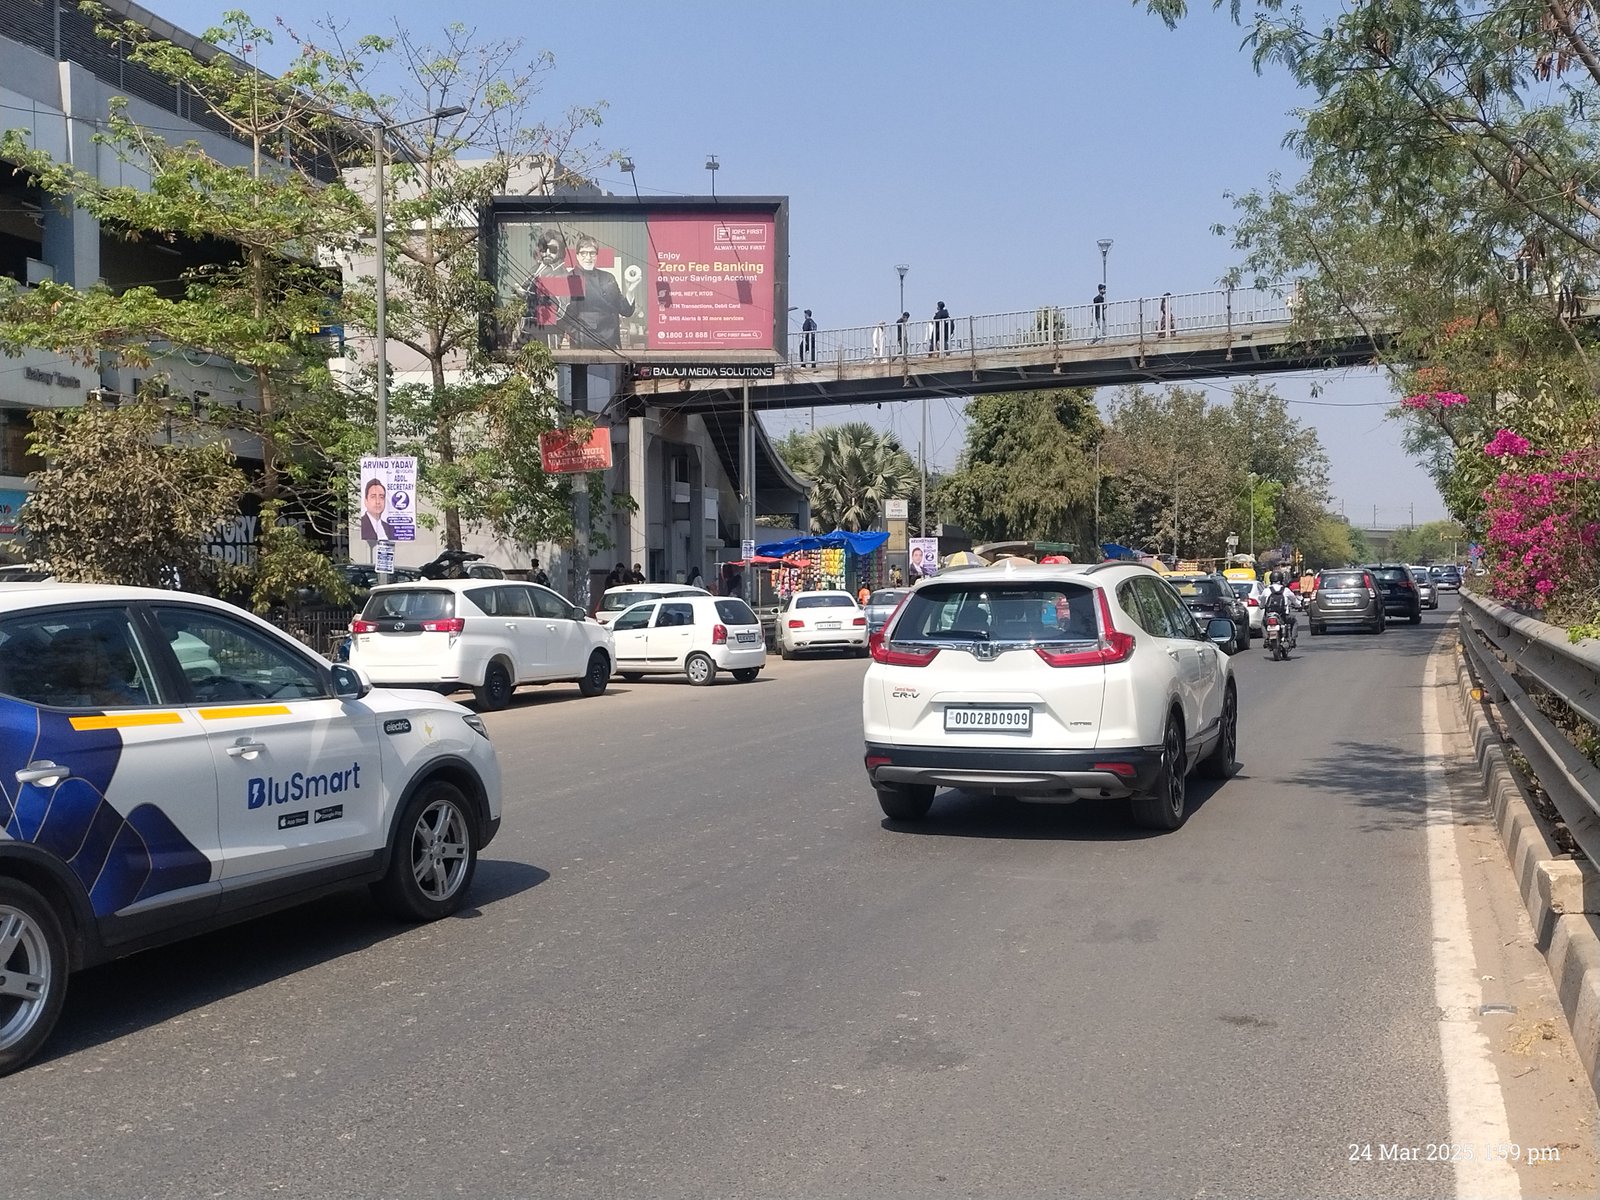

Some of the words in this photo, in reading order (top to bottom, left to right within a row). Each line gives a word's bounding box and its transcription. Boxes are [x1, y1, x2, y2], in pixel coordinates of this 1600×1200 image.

[657, 251, 681, 260] Enjoy
[657, 262, 686, 272] Zero
[688, 262, 710, 272] Fee
[713, 261, 764, 274] Banking
[670, 275, 688, 283] your
[690, 274, 722, 283] Savings
[665, 331, 683, 339] 1800
[685, 331, 693, 339] 10
[652, 367, 687, 377] BALAJI
[688, 367, 719, 377] MEDIA
[719, 367, 773, 377] SOLUTIONS
[362, 460, 389, 469] ARVIND
[391, 460, 414, 469] YADAV
[395, 491, 407, 508] 2
[892, 691, 920, 699] CR-V
[955, 712, 1028, 725] OD02BD0909
[386, 720, 410, 732] electric
[247, 761, 360, 810] BluSmart
